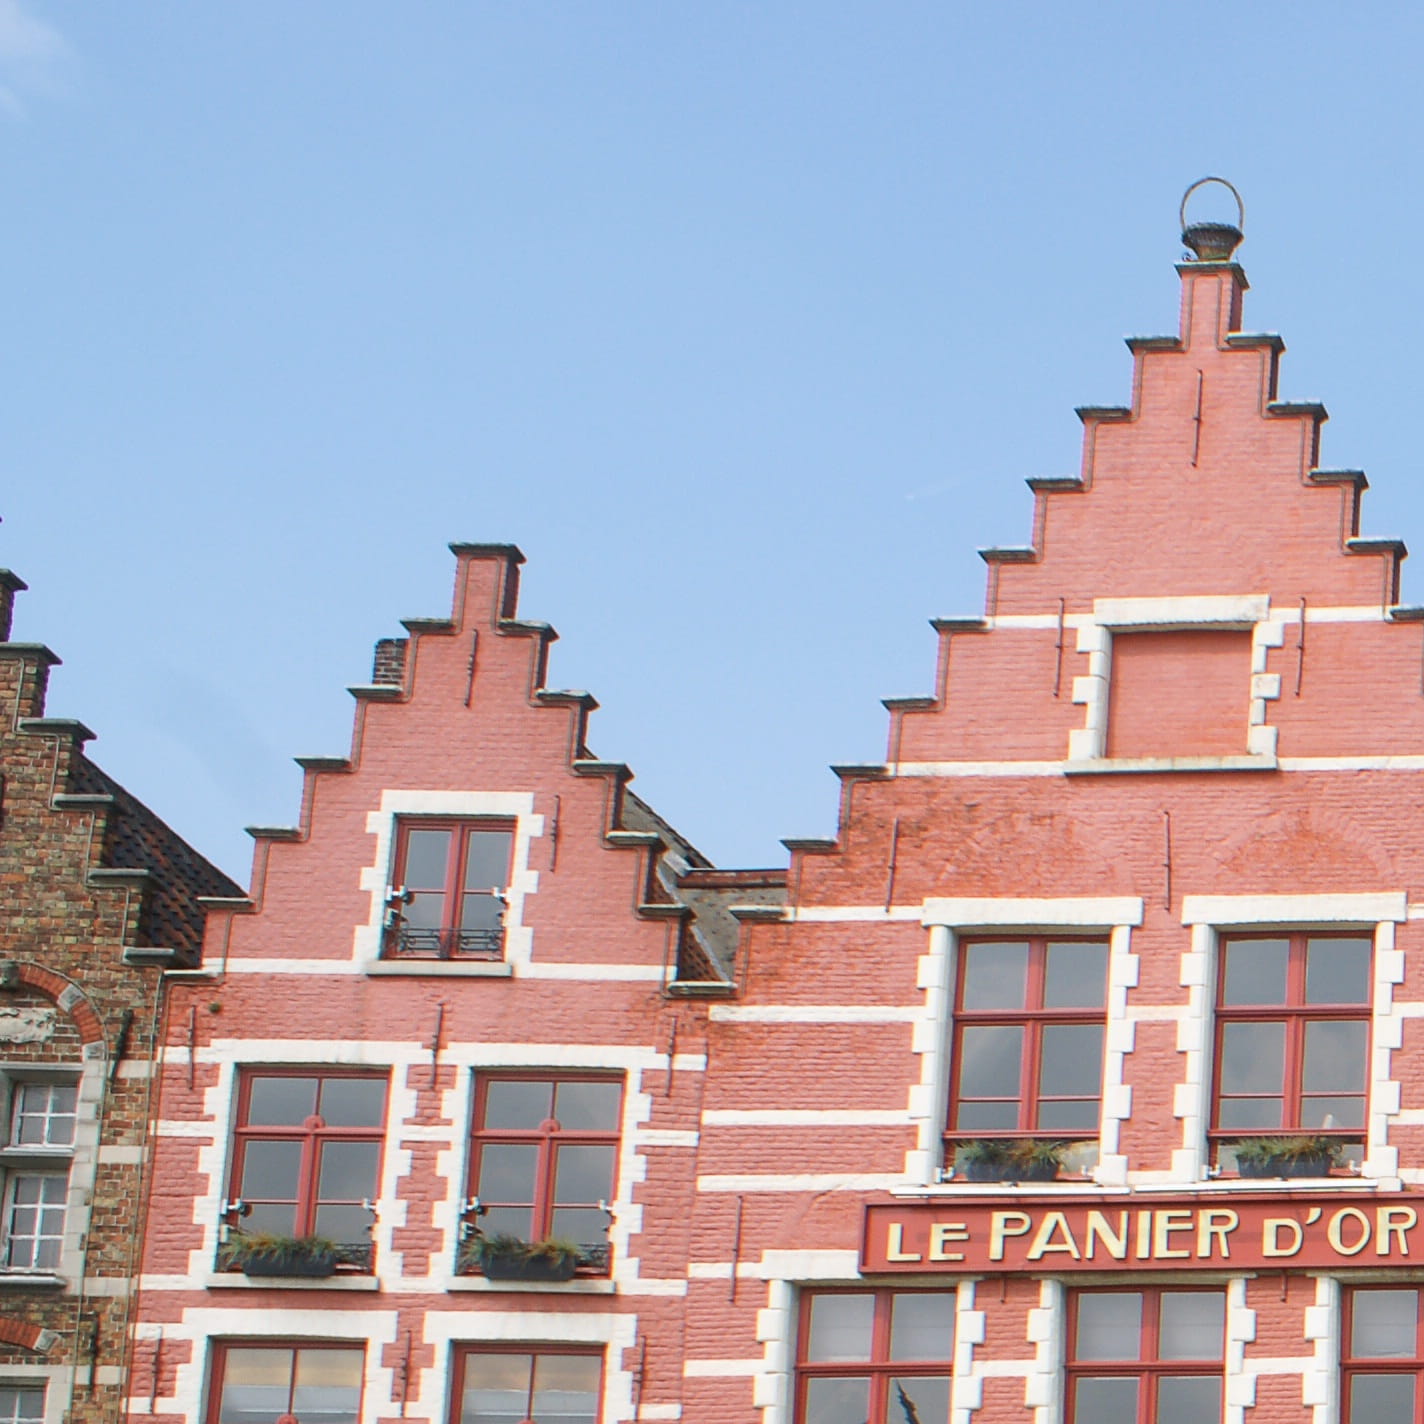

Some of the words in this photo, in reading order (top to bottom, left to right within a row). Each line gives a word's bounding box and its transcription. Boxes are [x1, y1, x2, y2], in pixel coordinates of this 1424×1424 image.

[886, 1222, 970, 1264] LE
[988, 1208, 1240, 1262] PANIER
[1262, 1206, 1418, 1258] D'OR
